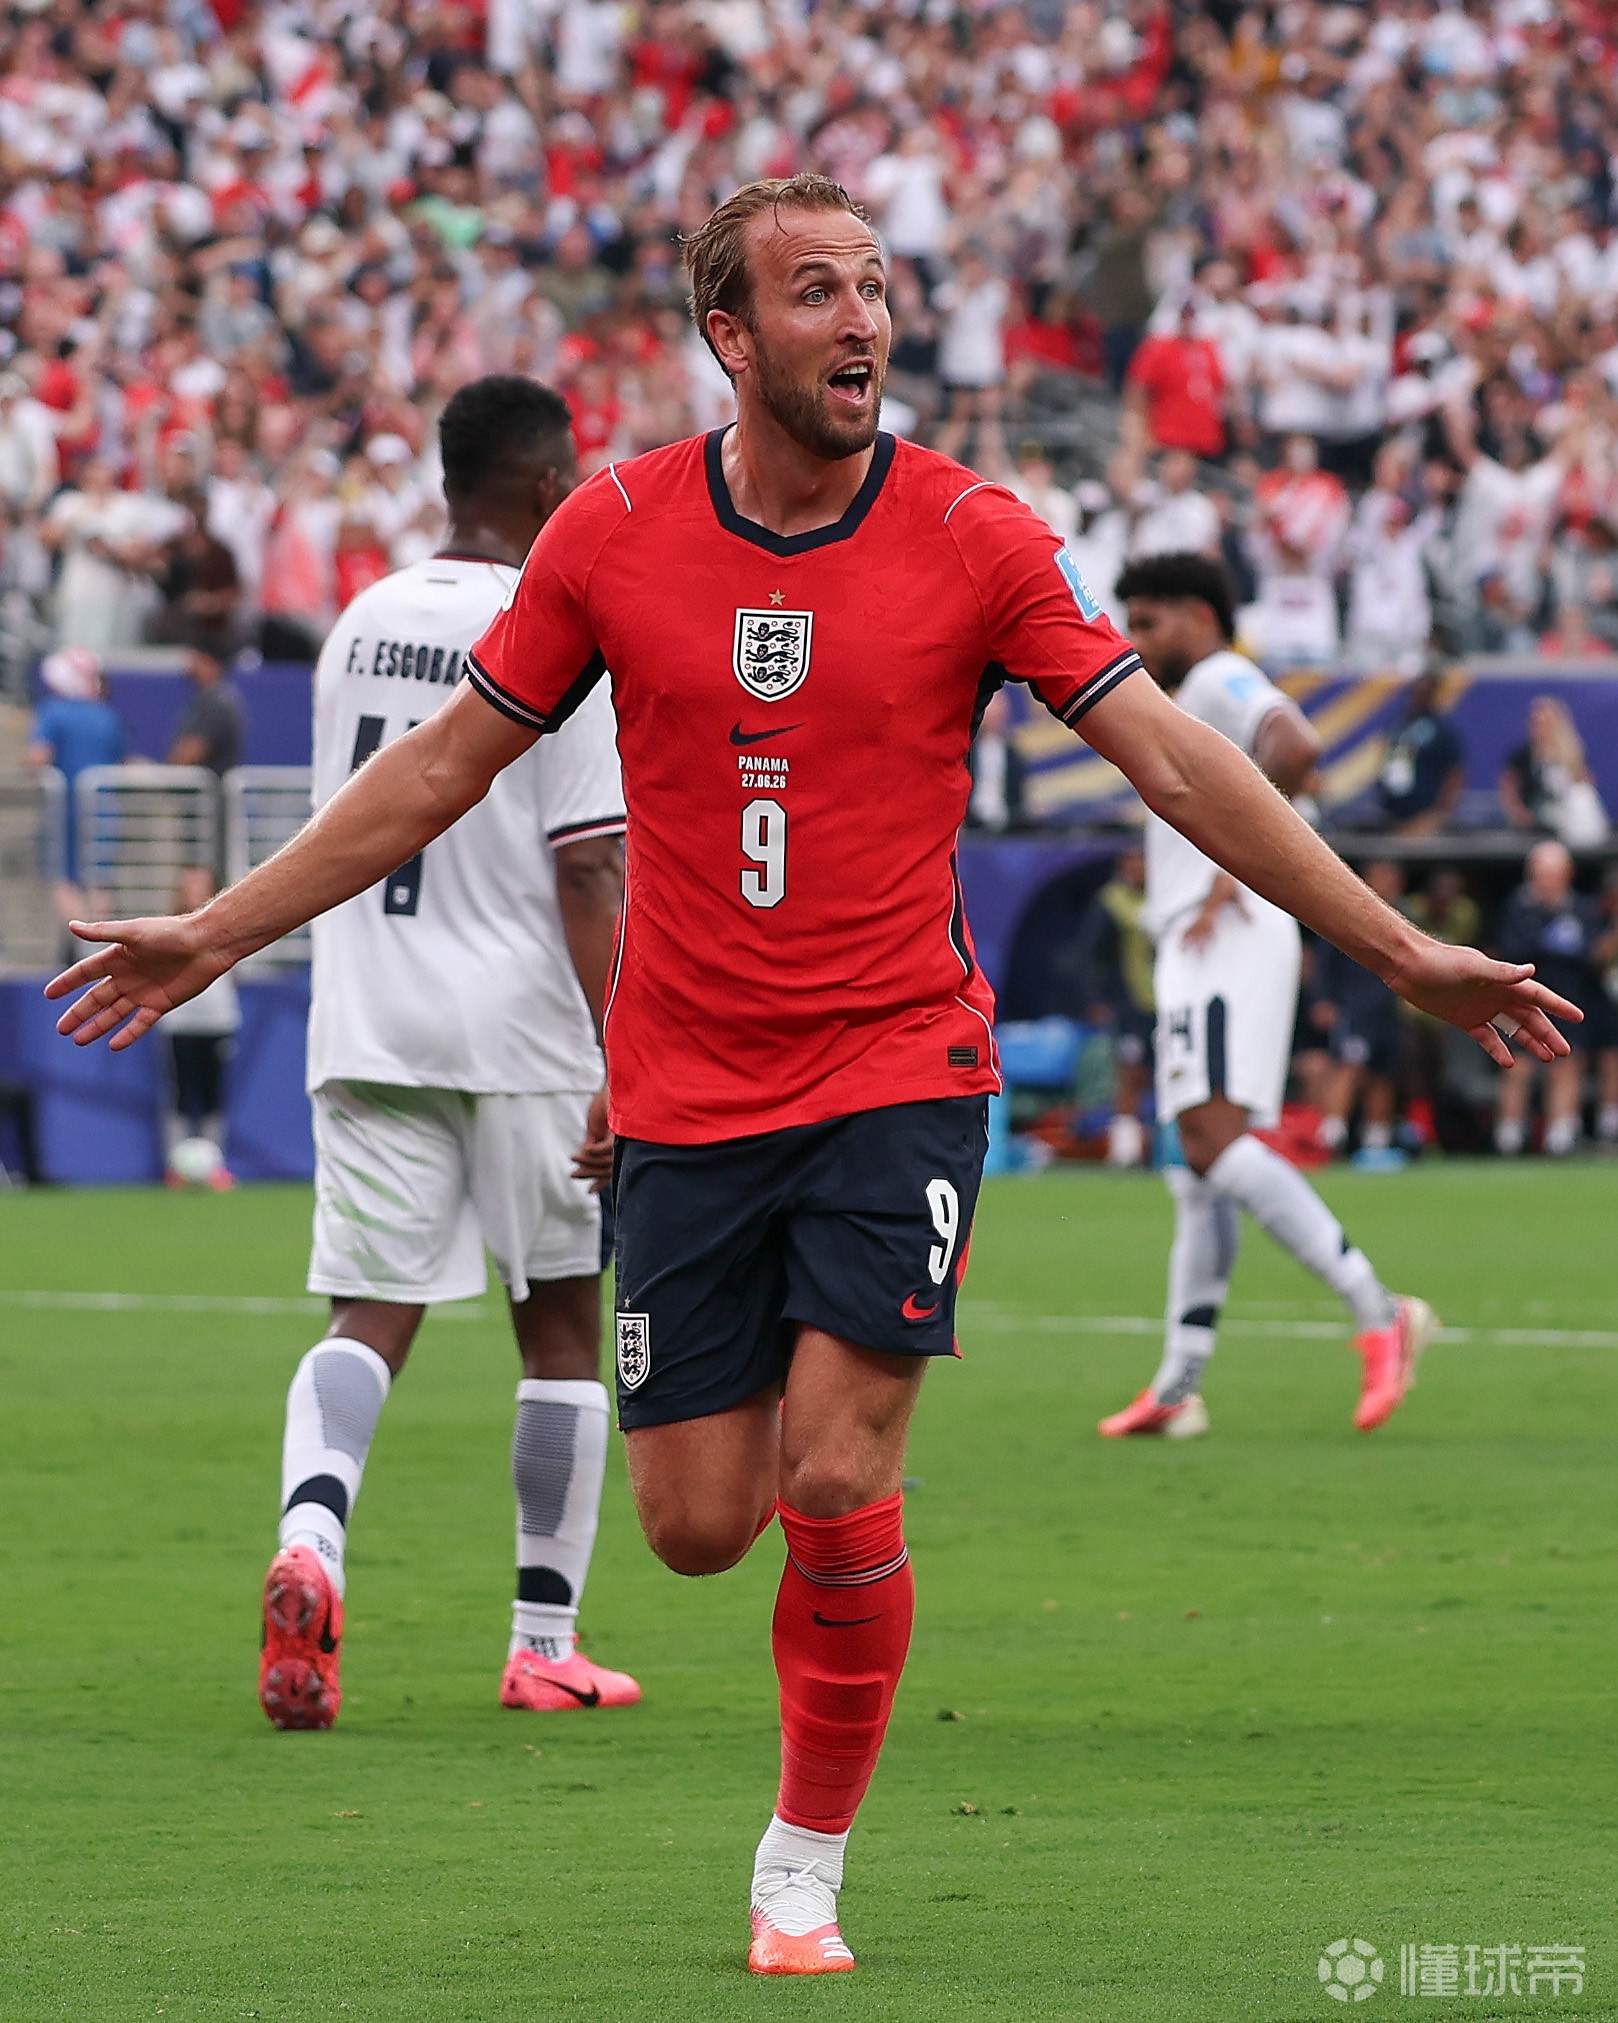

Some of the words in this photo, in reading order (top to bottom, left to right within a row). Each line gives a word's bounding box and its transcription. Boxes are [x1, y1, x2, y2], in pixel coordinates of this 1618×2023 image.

[347, 638, 364, 675] F.
[372, 640, 469, 686] ESCOBA
[738, 755, 790, 772] PANAMA
[741, 773, 787, 789] 27.06.26
[740, 798, 788, 909] 9
[925, 1177, 960, 1286] 9
